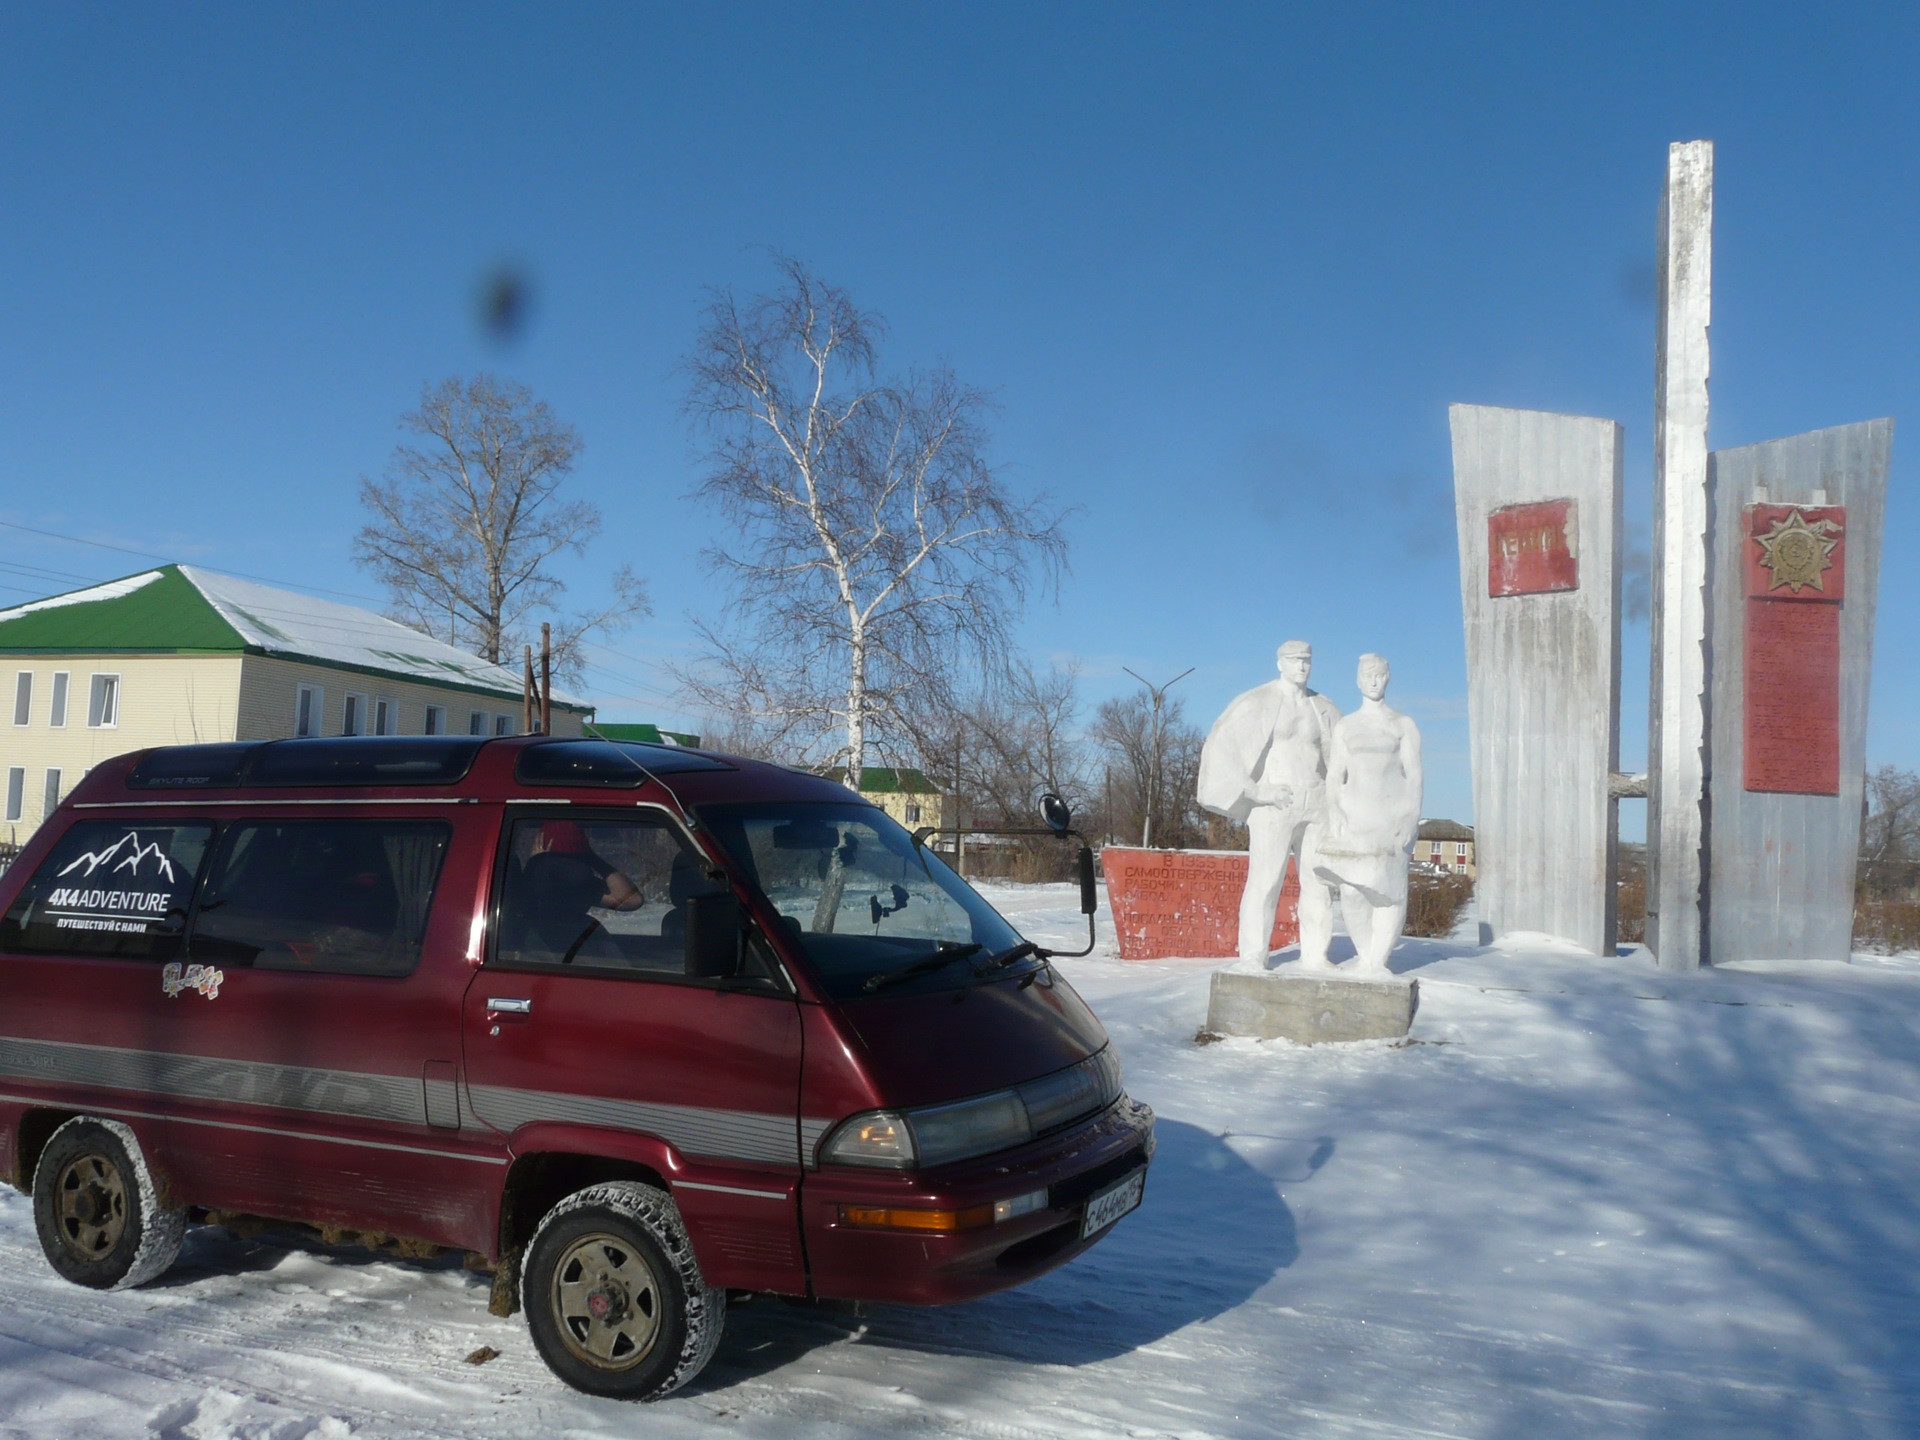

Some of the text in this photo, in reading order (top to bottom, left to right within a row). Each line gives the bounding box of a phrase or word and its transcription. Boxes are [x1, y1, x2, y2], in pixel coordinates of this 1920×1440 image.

[1163, 854, 1248, 871] В 1955 ГОД
[1125, 866, 1248, 883] САМООТВЕРЖЕННЫ
[1125, 878, 1182, 891] РАБОЧИХ
[57, 918, 147, 933] ПУТЕШЕСТВУЙ С НАМИ
